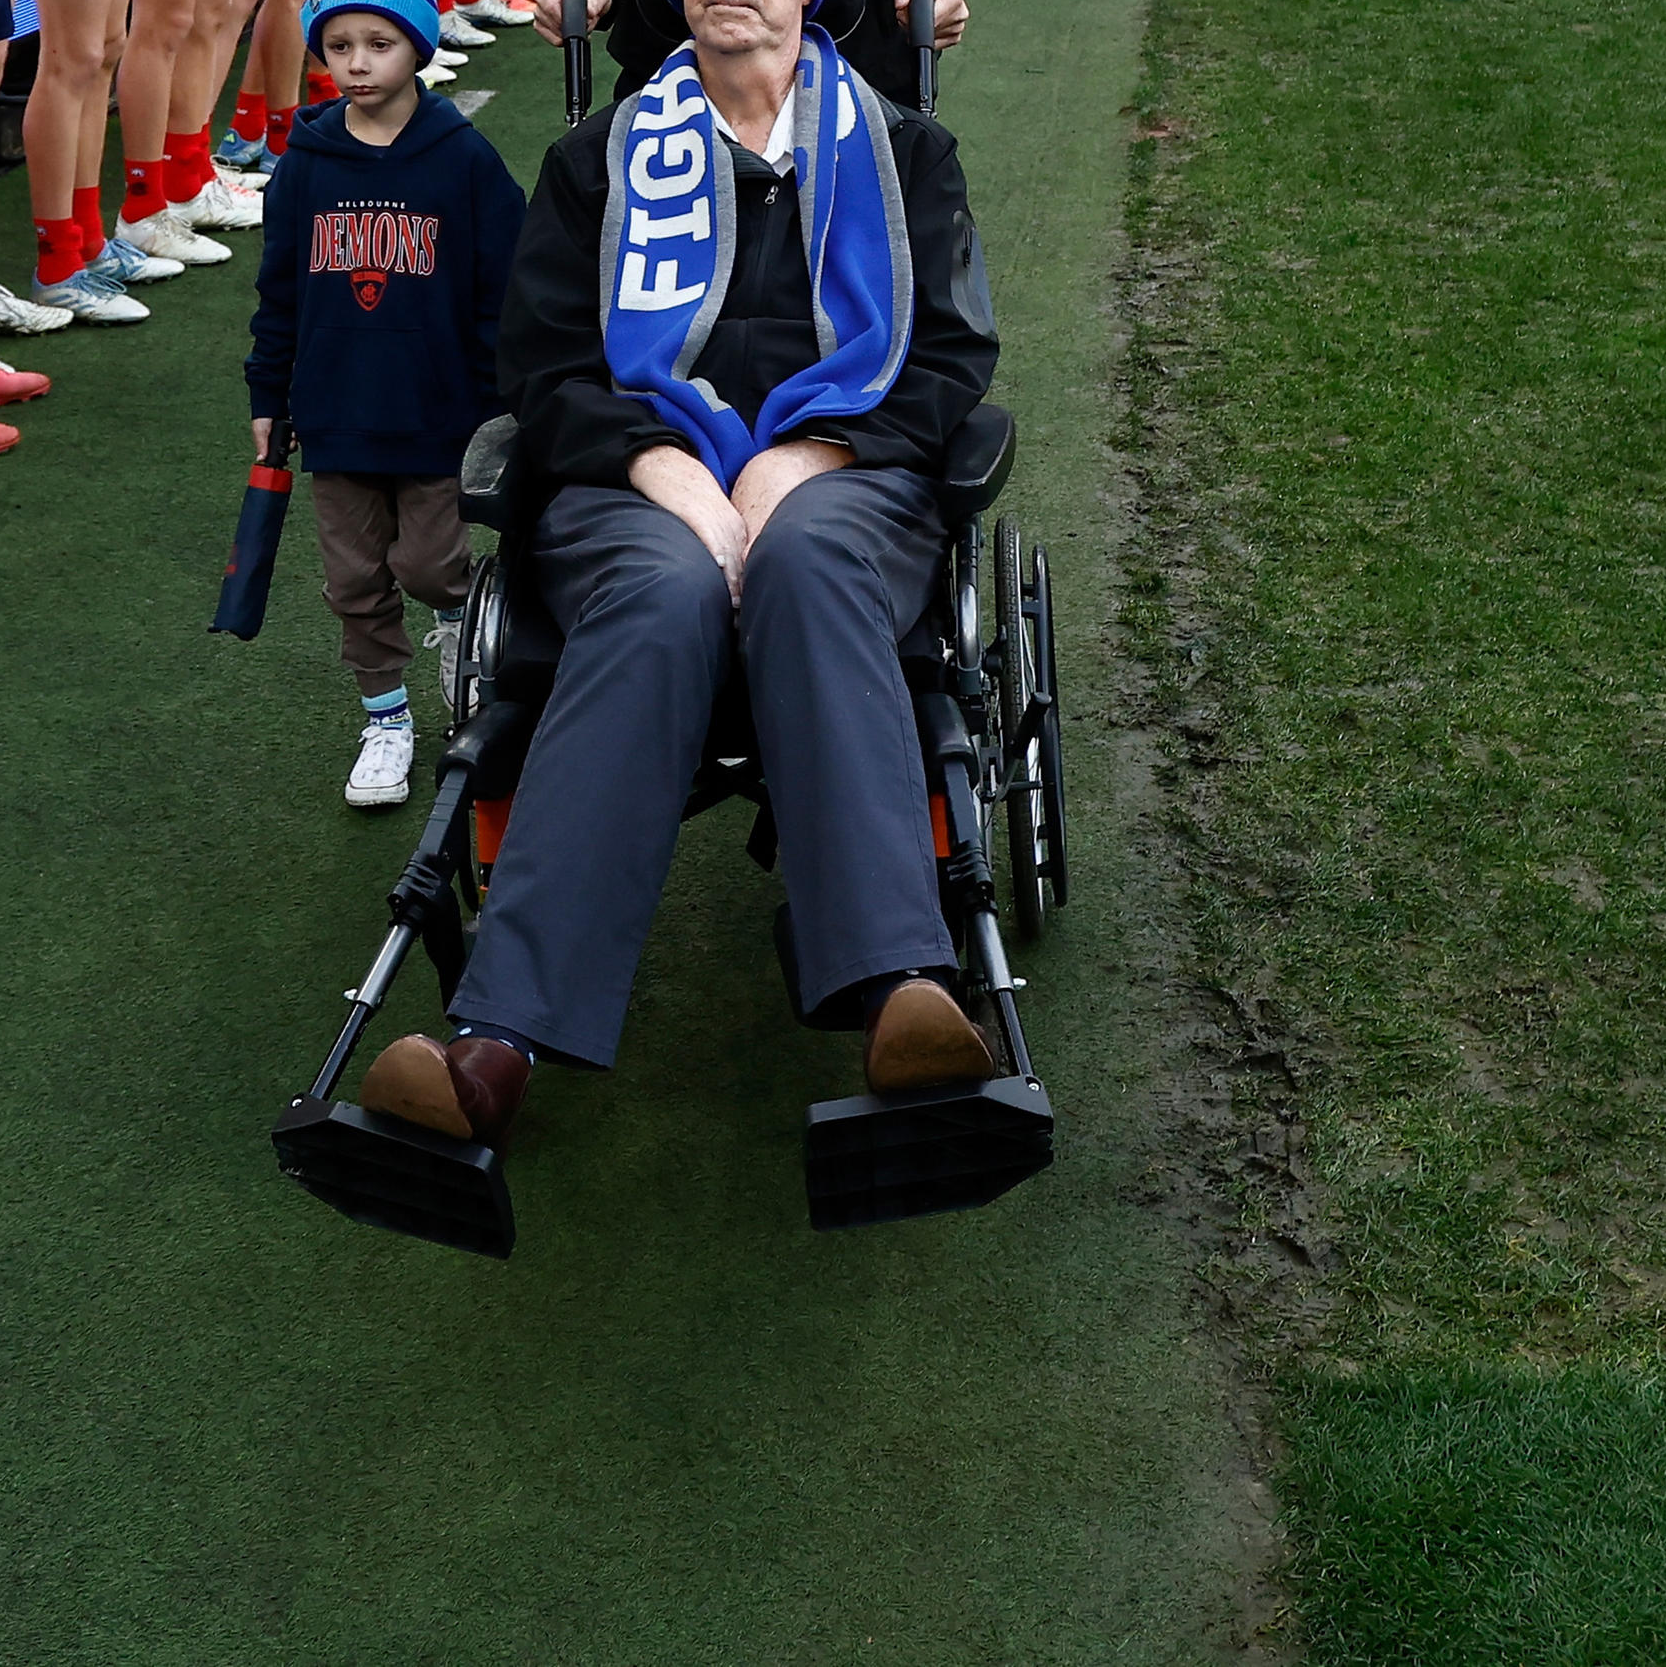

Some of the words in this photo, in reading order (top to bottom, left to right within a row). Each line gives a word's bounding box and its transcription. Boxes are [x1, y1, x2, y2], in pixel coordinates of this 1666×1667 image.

[337, 200, 406, 211] MELBOURNE
[617, 43, 713, 312] FIGH
[308, 211, 439, 276] DEMONS
